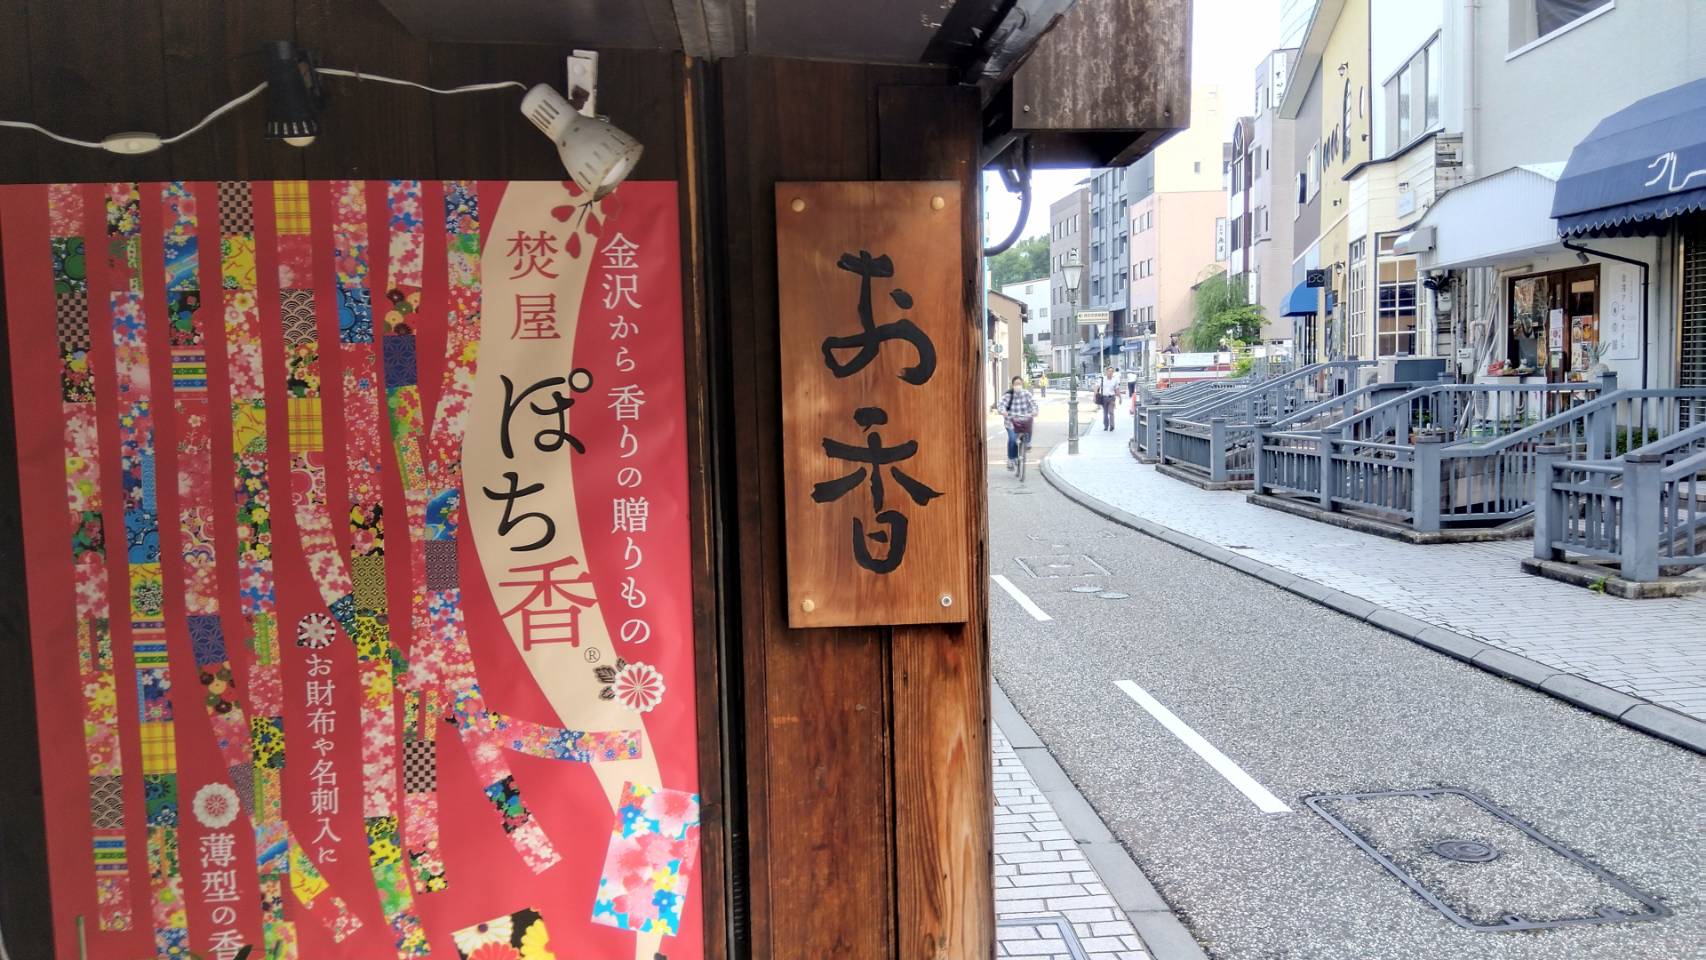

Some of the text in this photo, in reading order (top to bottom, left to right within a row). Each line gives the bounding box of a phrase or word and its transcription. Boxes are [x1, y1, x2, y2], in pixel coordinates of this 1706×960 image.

[506, 230, 562, 341] 焚屋
[810, 250, 945, 575] お香
[599, 231, 652, 646] 金沢から香りの贈りもの
[304, 653, 342, 864] お財布や名刺入に
